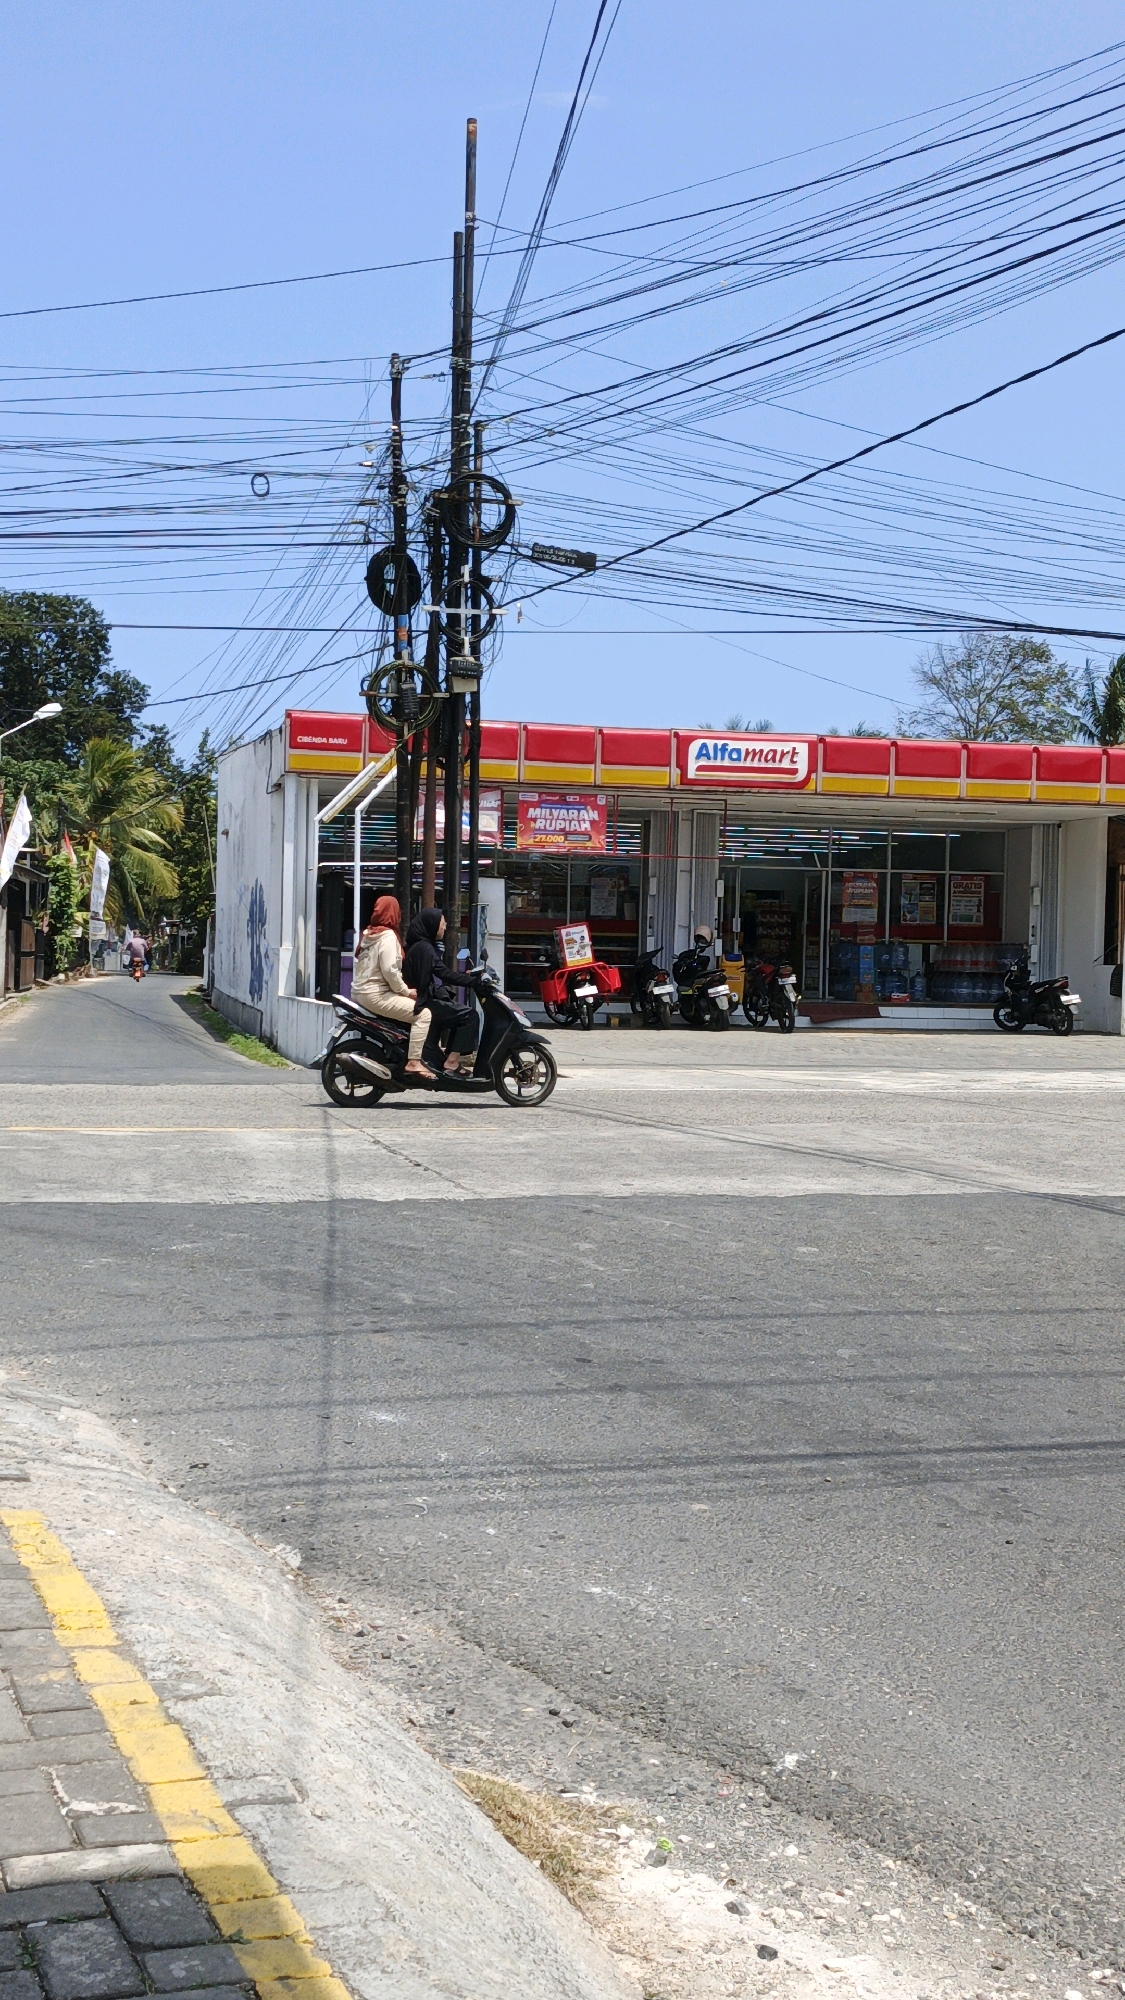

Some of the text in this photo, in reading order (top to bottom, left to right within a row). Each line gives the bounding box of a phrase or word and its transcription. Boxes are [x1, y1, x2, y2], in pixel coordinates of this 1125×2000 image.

[695, 742, 799, 764] Alfamart
[527, 808, 599, 820] MILYARAN
[535, 818, 591, 831] RUPIAH
[952, 881, 983, 890] GRATIS
